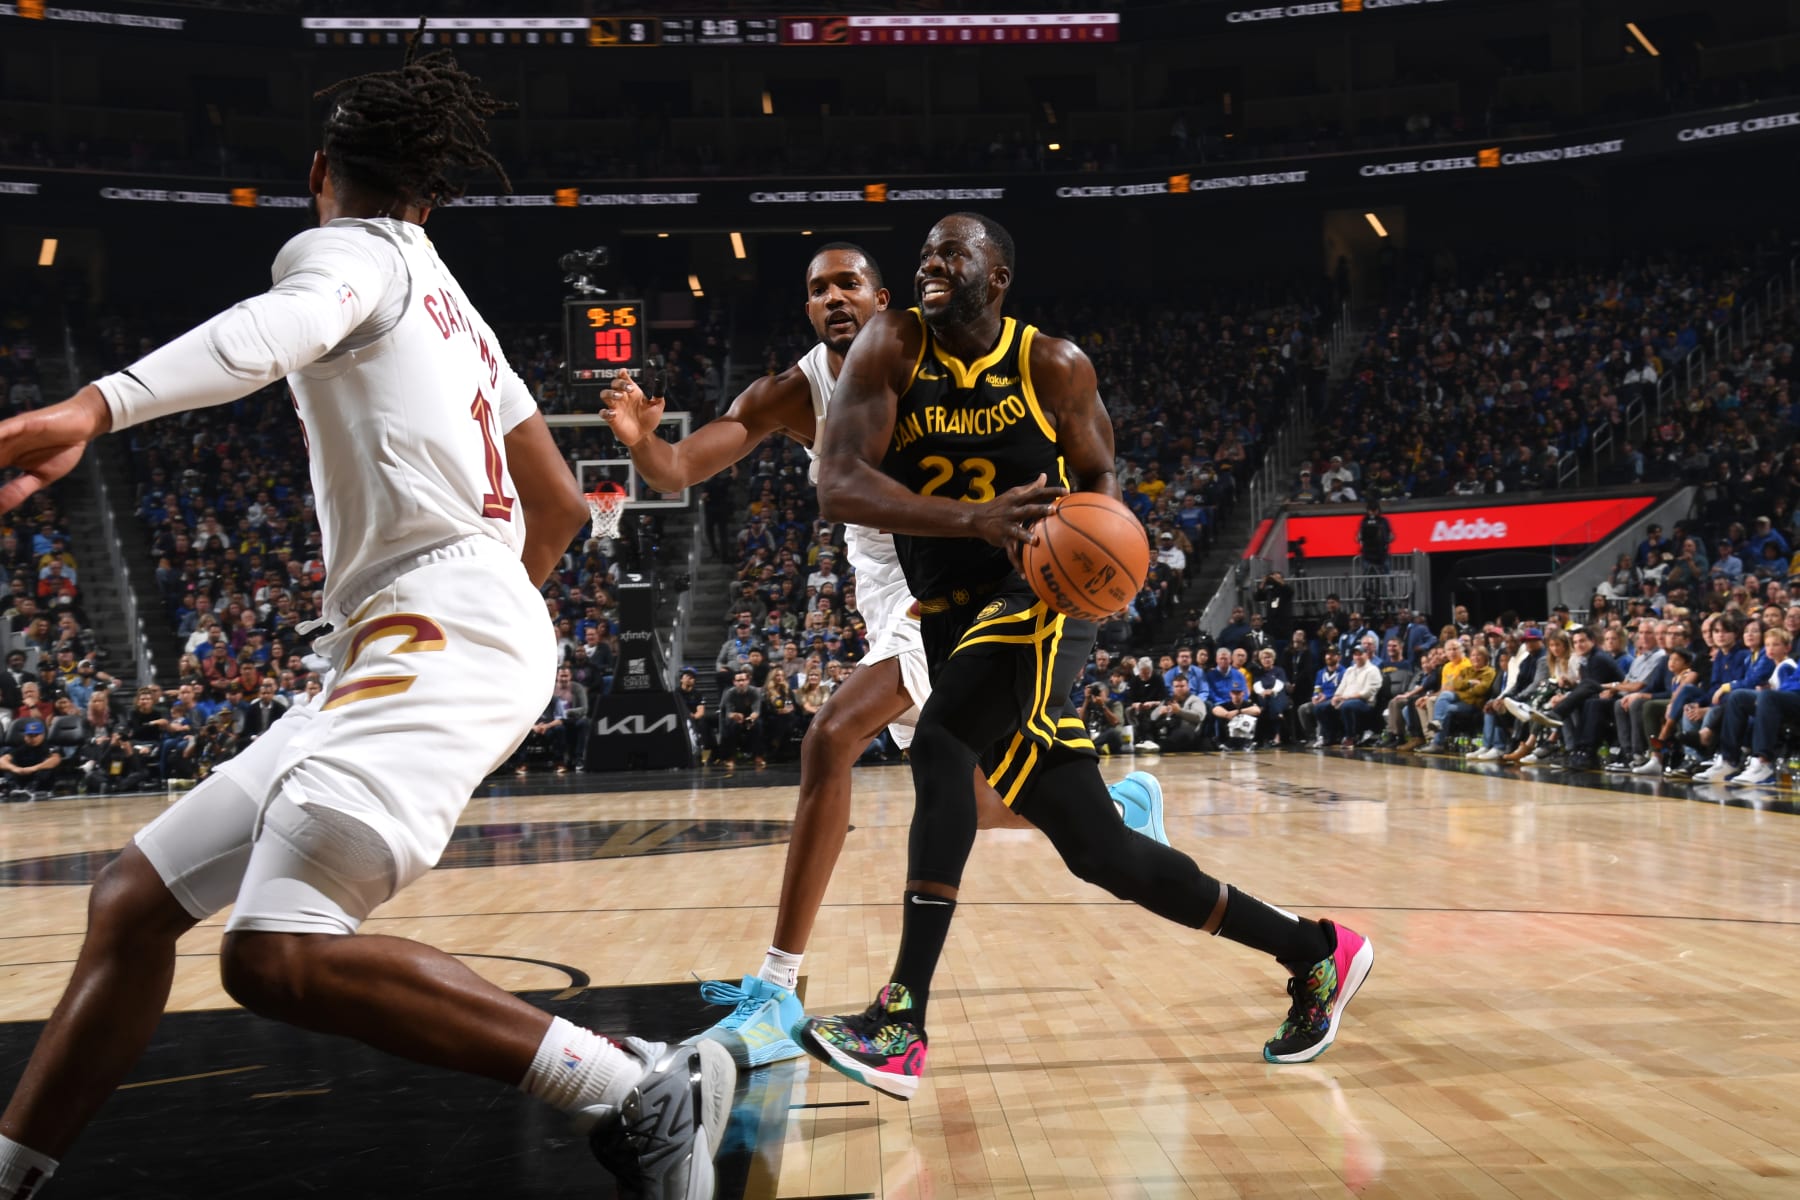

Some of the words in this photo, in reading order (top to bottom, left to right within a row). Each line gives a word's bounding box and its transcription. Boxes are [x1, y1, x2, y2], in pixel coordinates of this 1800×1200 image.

[1226, 7, 1284, 23] CACHE
[1285, 1, 1340, 16] CREEK
[792, 22, 813, 40] 10
[1677, 122, 1740, 141] CACHE
[1741, 112, 1800, 131] CREEK
[1360, 162, 1419, 176] CACHE
[1420, 157, 1477, 171] CREEK
[1501, 150, 1563, 165] CASINO
[1563, 140, 1624, 158] RESORT
[750, 191, 809, 202] CACHE
[809, 190, 864, 202] CREEK
[886, 189, 945, 200] CASINO
[945, 188, 1005, 200] RESORT
[1056, 186, 1114, 198] CACHE
[1114, 183, 1168, 196] CREEK
[1190, 176, 1249, 190] CASINO
[1249, 171, 1308, 186] RESORT
[595, 328, 632, 362] 10
[925, 395, 1026, 435] FRANCISCO
[917, 455, 996, 504] 23
[1430, 518, 1507, 542] Adobe
[620, 630, 651, 642] xfinity
[598, 714, 677, 735] KIA
